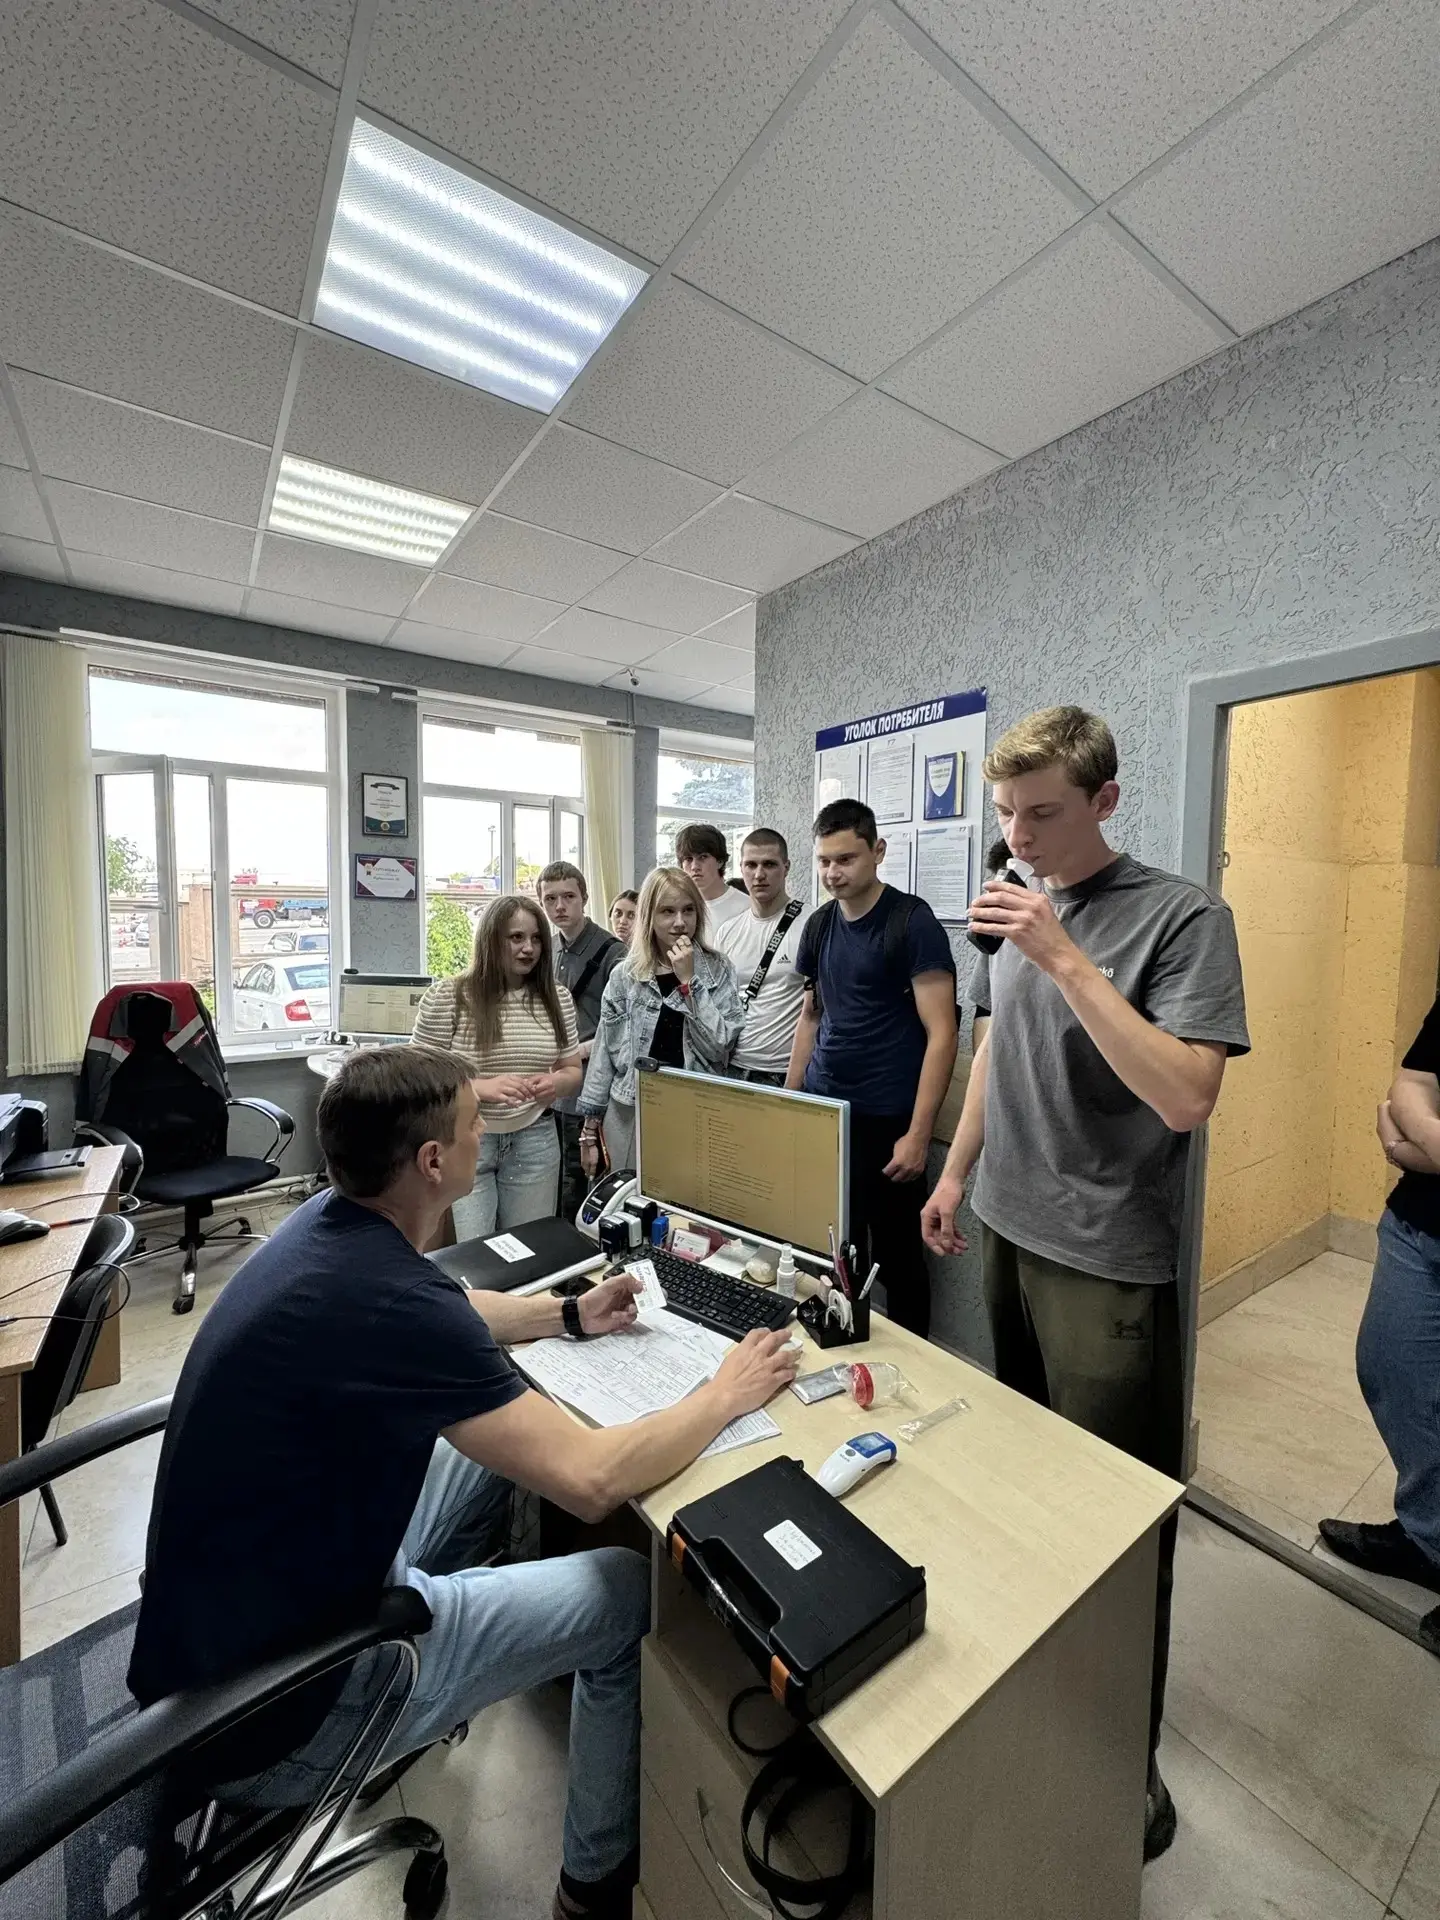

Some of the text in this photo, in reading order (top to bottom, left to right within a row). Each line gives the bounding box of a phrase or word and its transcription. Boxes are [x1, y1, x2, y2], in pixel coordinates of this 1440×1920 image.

[844, 701, 945, 742] УГОЛОК ПОТРЕБИТЕЛЯ
[767, 929, 785, 953] HBK
[750, 965, 767, 989] HBK
